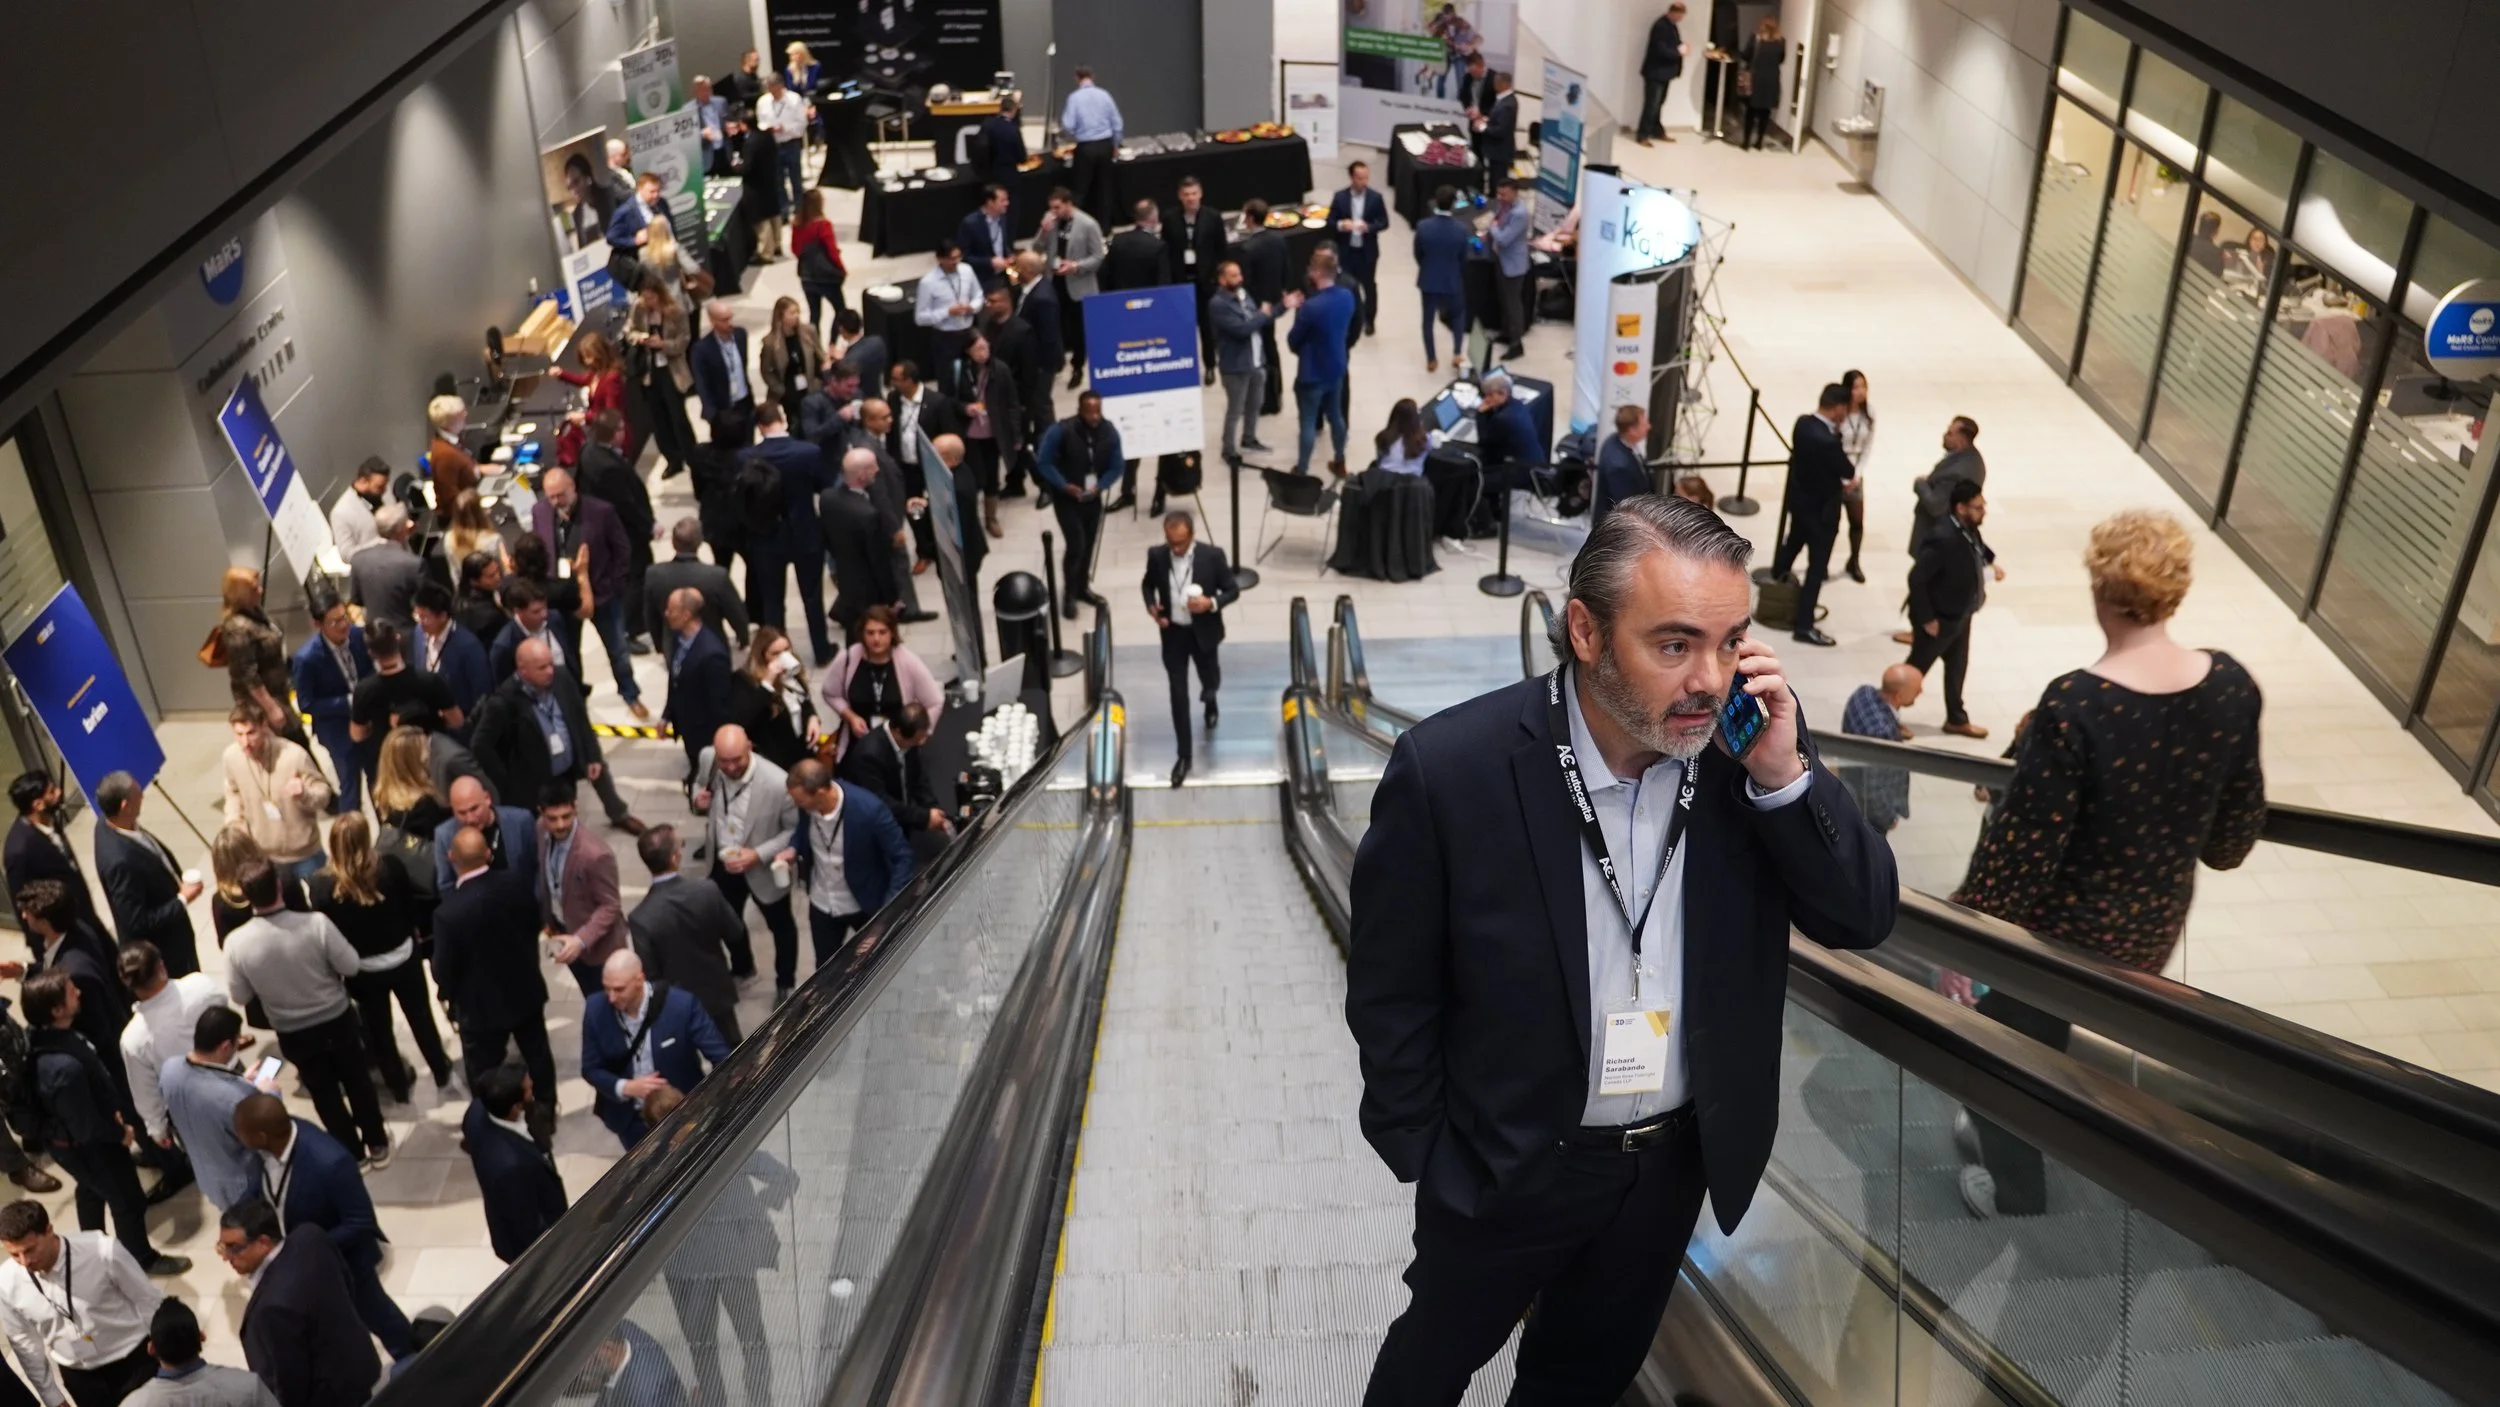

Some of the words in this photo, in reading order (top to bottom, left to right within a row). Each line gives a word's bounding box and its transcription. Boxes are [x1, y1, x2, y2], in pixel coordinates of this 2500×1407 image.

[203, 236, 242, 283] MaRS
[2446, 333, 2475, 345] MaRS
[1115, 347, 1171, 362] Canadian
[1093, 363, 1142, 380] Lenders
[1144, 357, 1194, 374] Summit!
[1563, 771, 1574, 794] CANADA
[1568, 770, 1595, 824] autocapital
[1605, 1065, 1646, 1073] Sarabando
[1606, 1057, 1635, 1065] Richard
